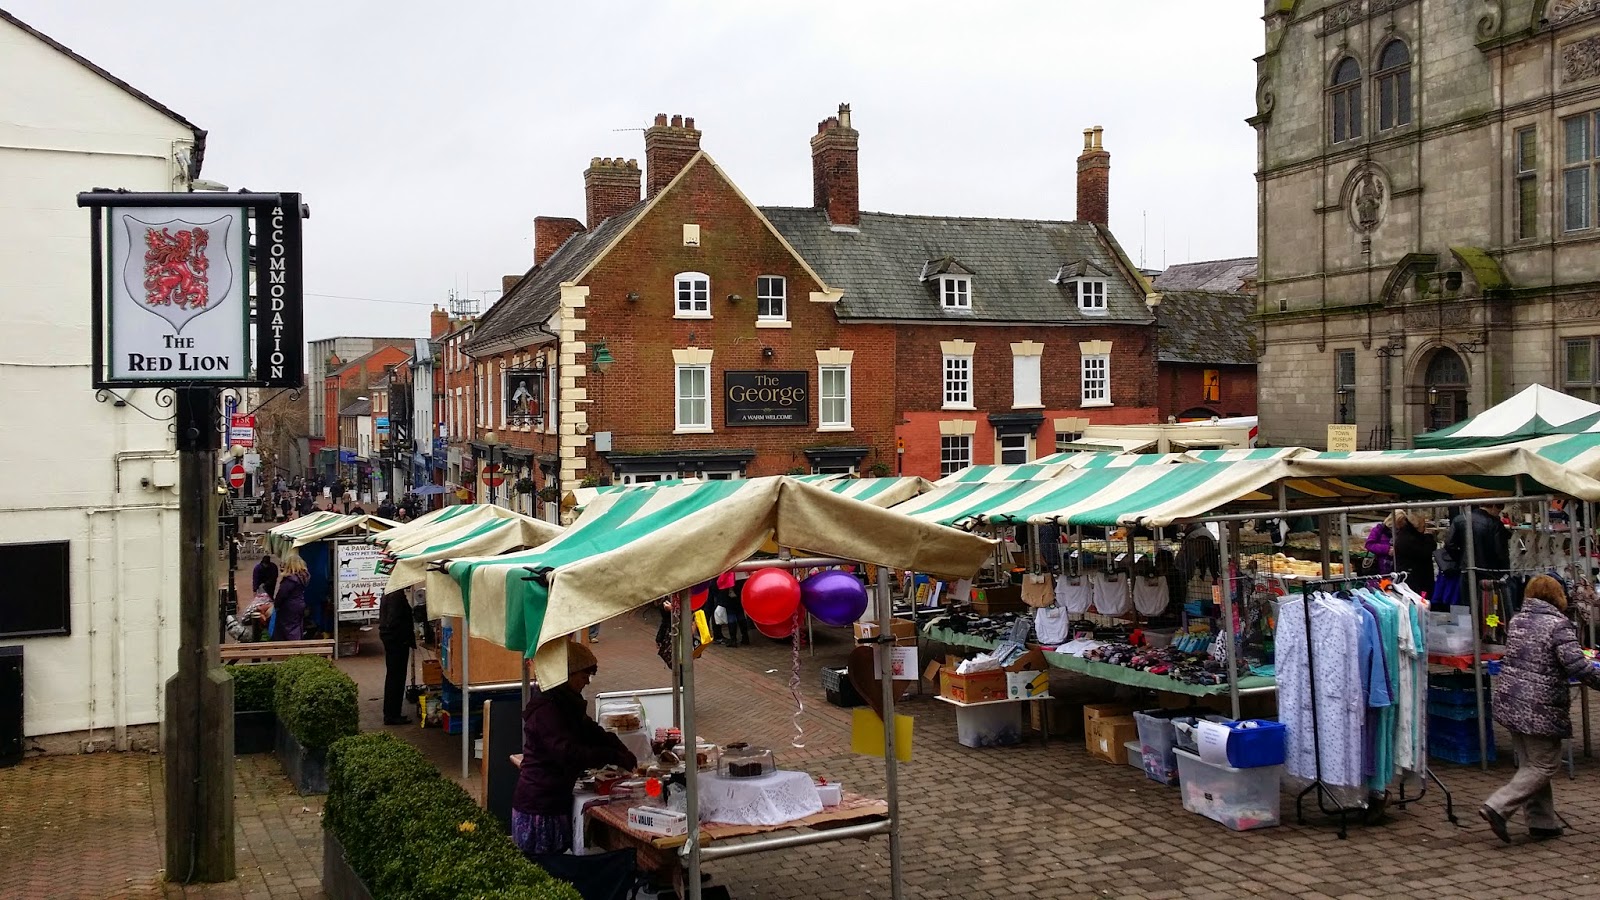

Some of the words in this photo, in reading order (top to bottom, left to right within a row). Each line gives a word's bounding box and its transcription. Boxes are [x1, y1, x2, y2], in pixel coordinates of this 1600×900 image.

[270, 206, 285, 378] ACCOMMODATION
[755, 375, 780, 386] The
[729, 385, 805, 407] George
[638, 815, 654, 827] VALUE
